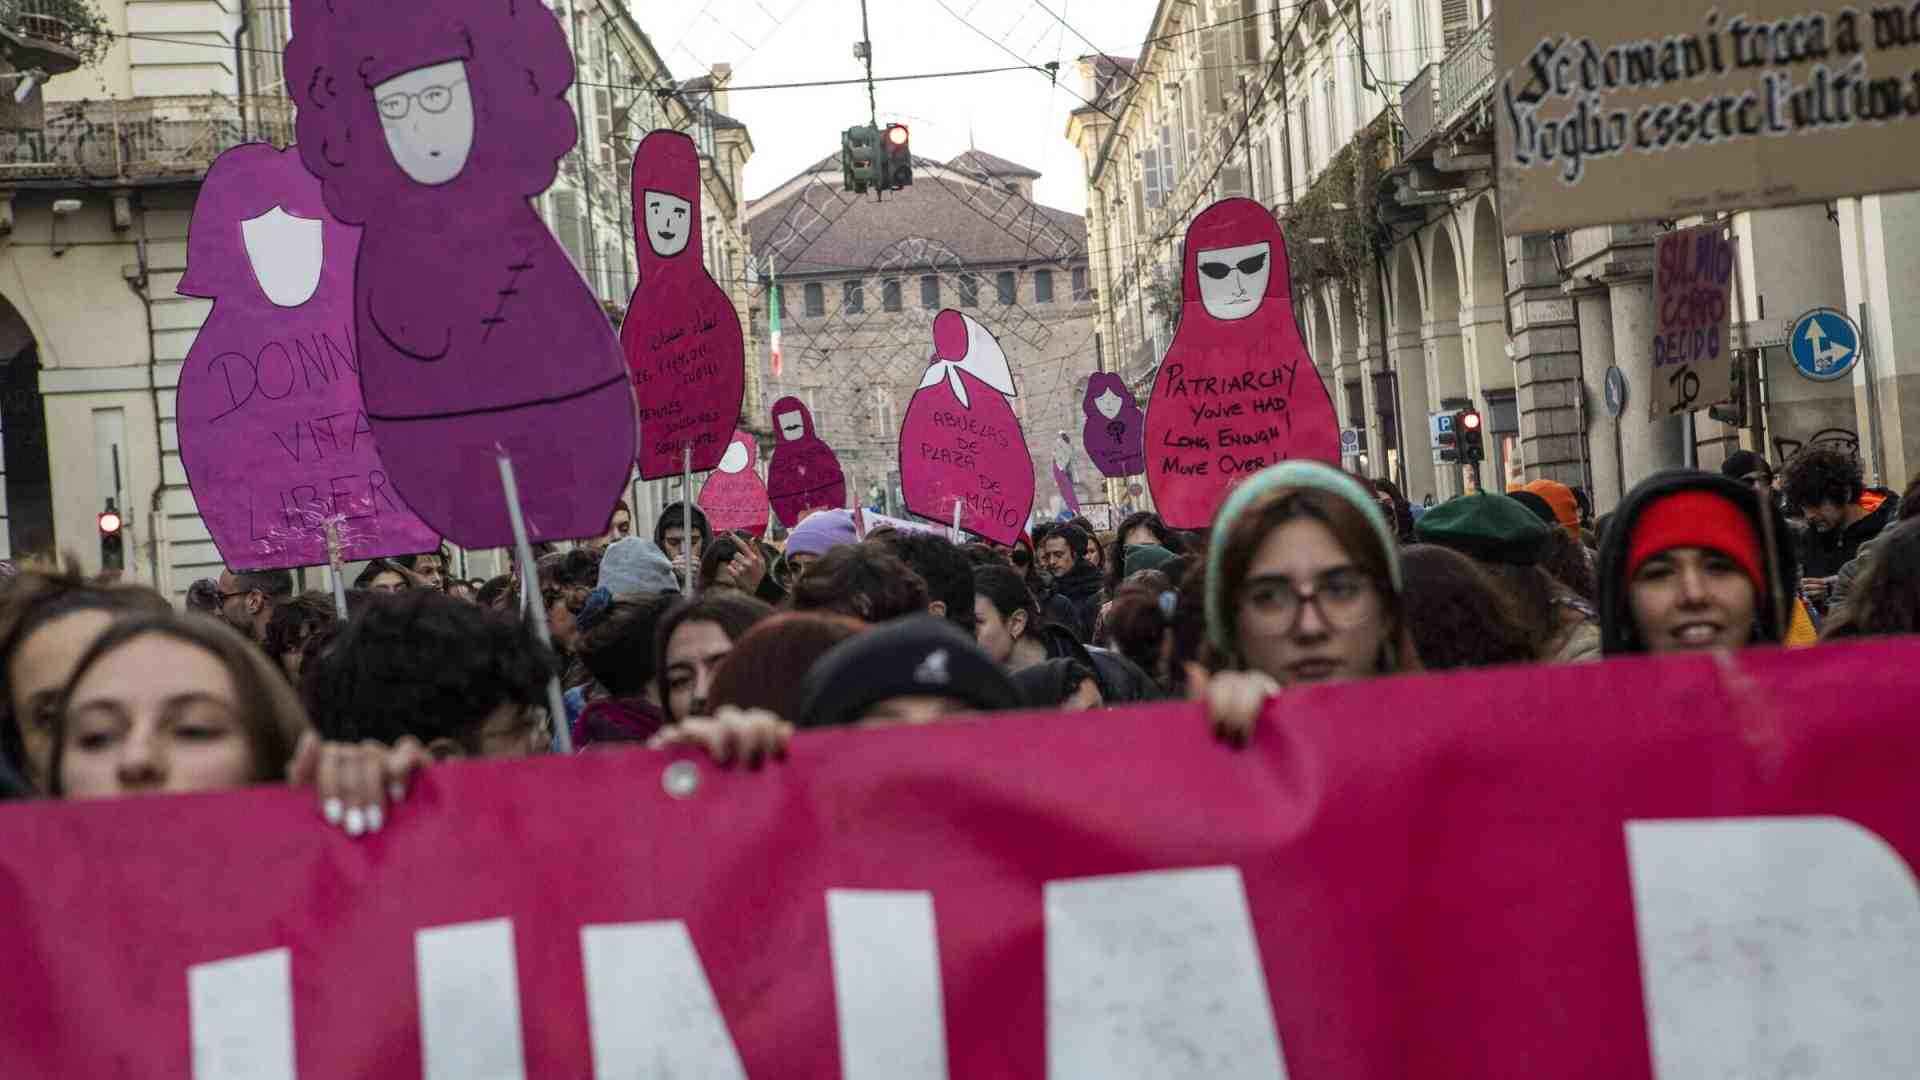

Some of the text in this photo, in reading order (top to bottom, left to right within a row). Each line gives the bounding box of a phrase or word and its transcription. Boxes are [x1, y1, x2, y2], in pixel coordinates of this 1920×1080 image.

[1579, 14, 1725, 91] domani
[1837, 7, 1862, 54] a
[1636, 97, 1762, 147] essere
[1654, 327, 1720, 368] DECIDO
[207, 324, 359, 424] DONN
[1166, 359, 1299, 398] PATRIARCHY
[1253, 396, 1287, 414] HAD
[272, 408, 372, 463] VITA
[933, 411, 1009, 448] ABUELAS
[957, 437, 979, 455] DE
[1163, 428, 1210, 450] LONG
[920, 442, 976, 471] PLAZA
[978, 474, 1001, 495] DE
[965, 491, 1019, 528] MAYO
